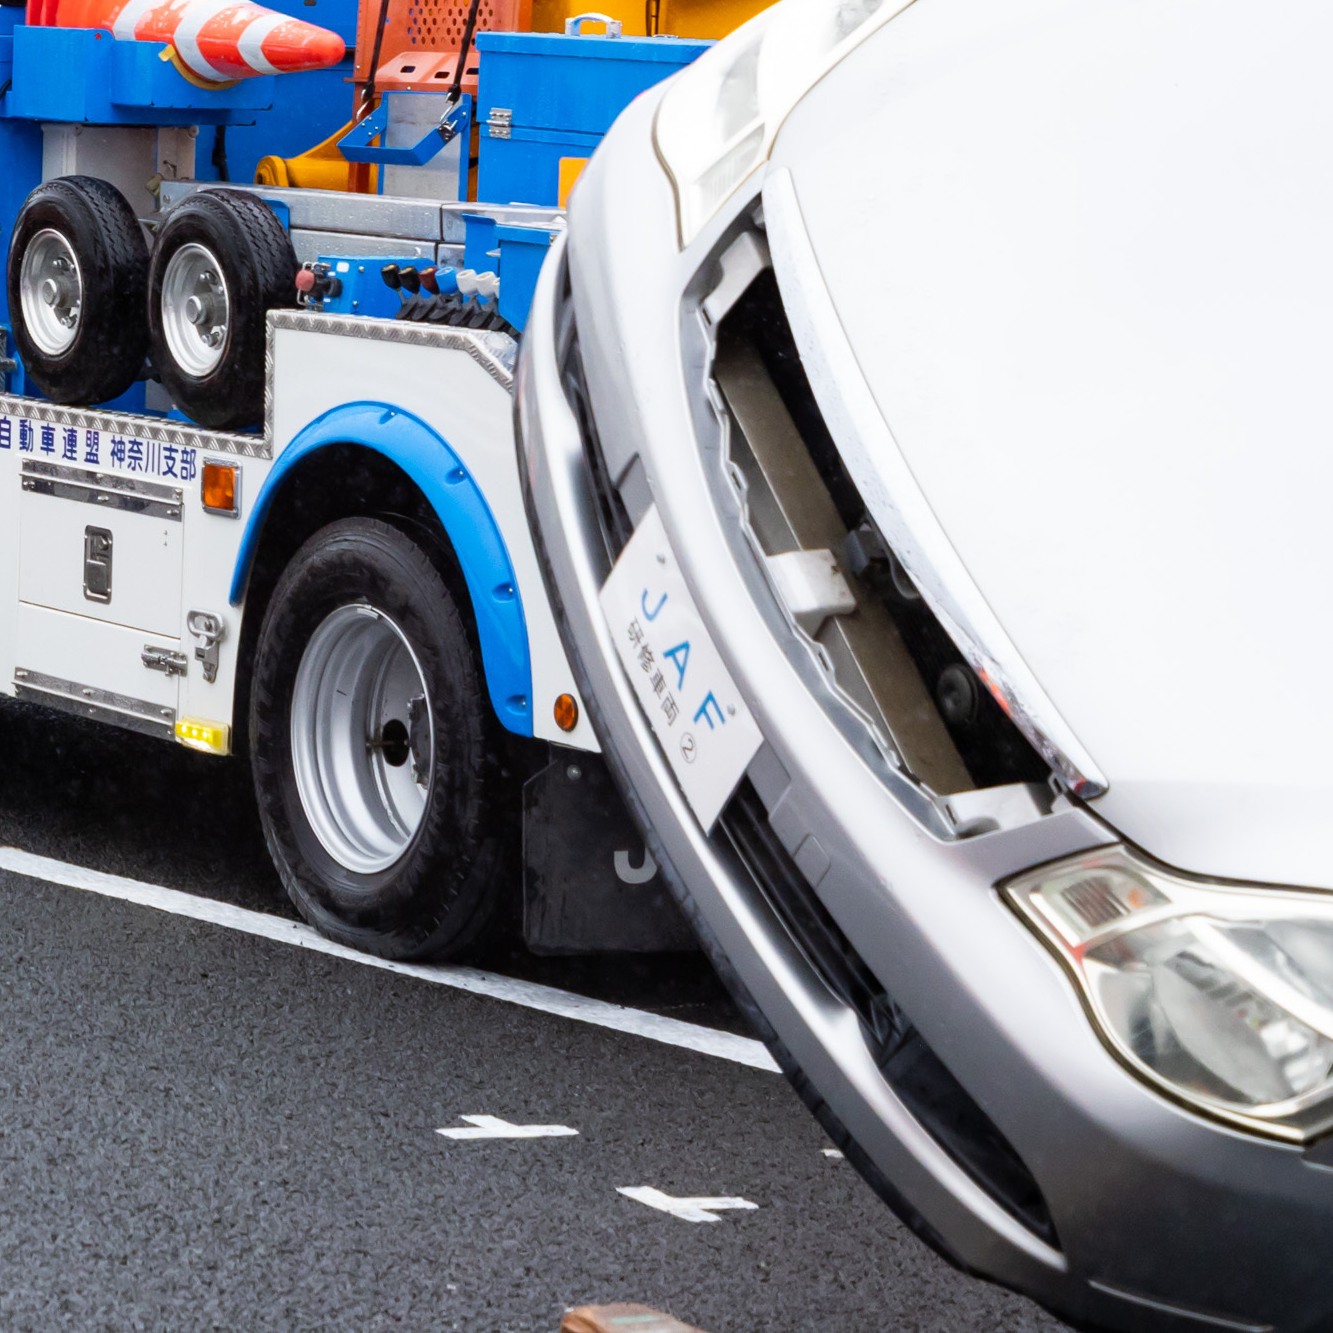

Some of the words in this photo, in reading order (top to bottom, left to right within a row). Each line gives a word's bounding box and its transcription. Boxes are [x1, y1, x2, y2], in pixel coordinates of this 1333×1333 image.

[110, 435, 197, 481] 神奈川支部
[627, 616, 680, 727] 研修車両
[642, 587, 726, 730] JAF
